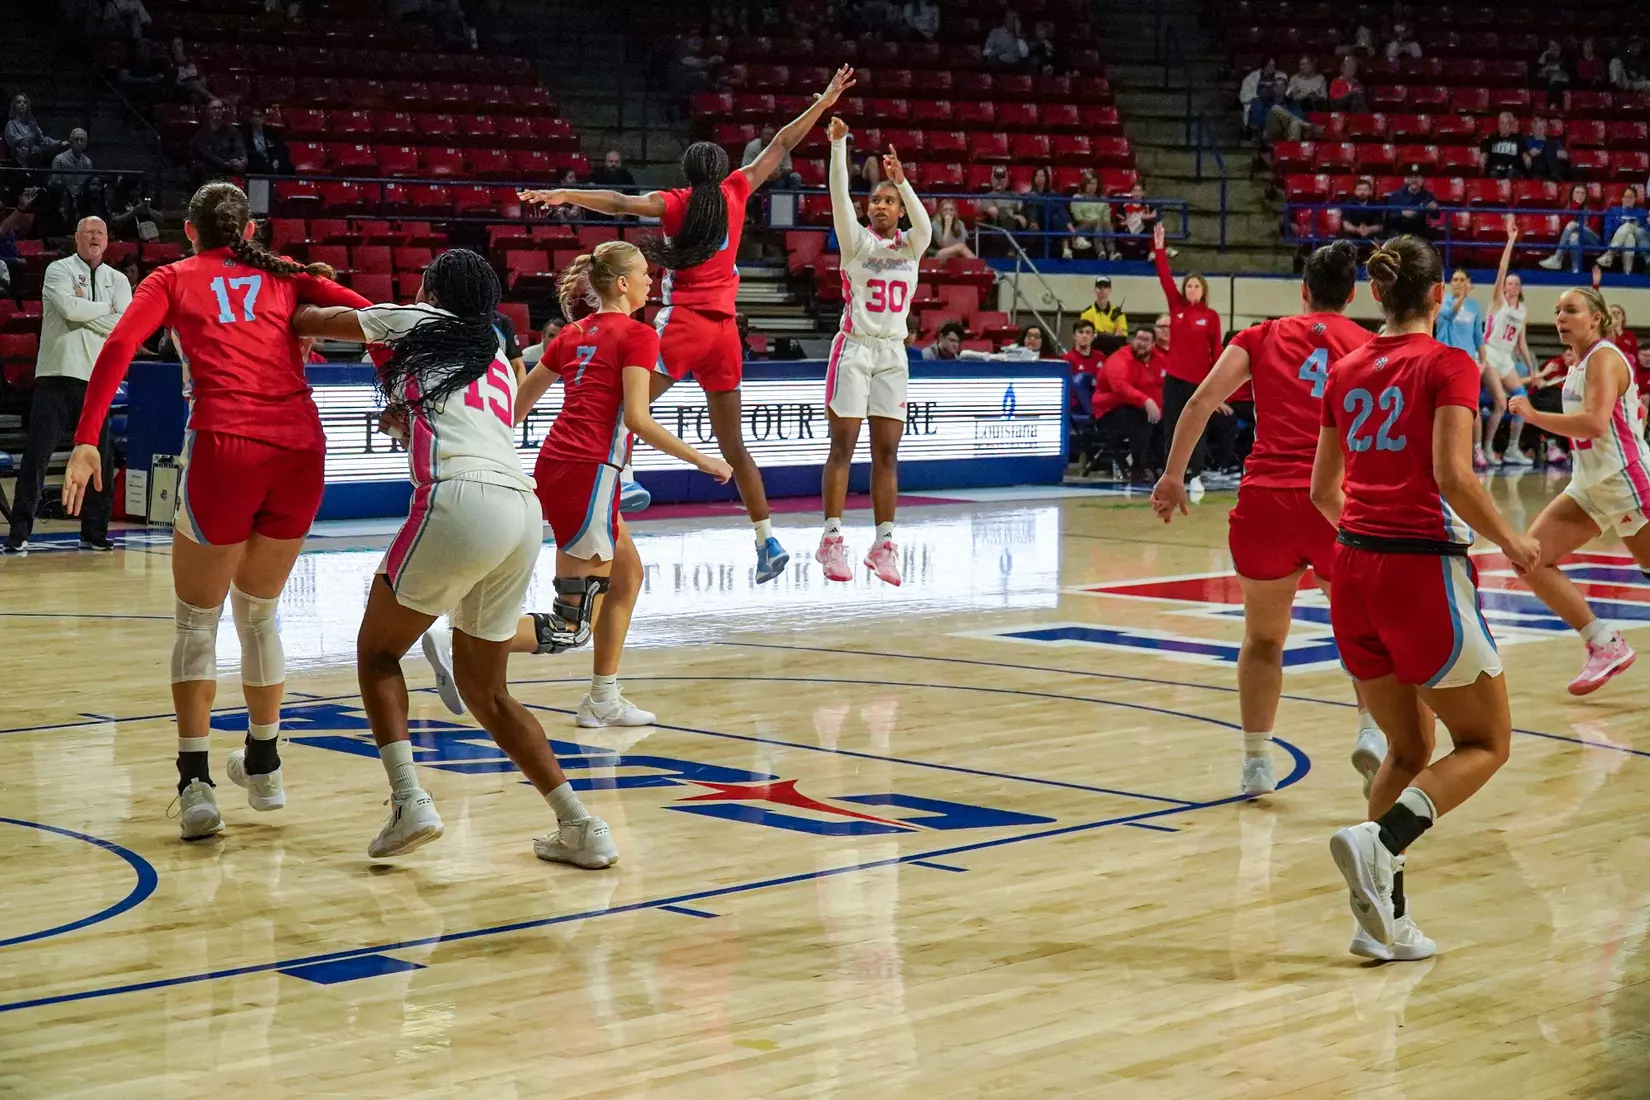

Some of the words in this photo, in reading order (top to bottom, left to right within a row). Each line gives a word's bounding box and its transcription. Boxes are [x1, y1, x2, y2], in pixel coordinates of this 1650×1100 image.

[209, 274, 262, 325] 17
[865, 278, 908, 313] 30
[574, 345, 598, 385] 7
[1298, 347, 1330, 399] 4
[464, 358, 513, 429] 15
[1343, 385, 1408, 453] 22
[974, 420, 1038, 440] Louisiana
